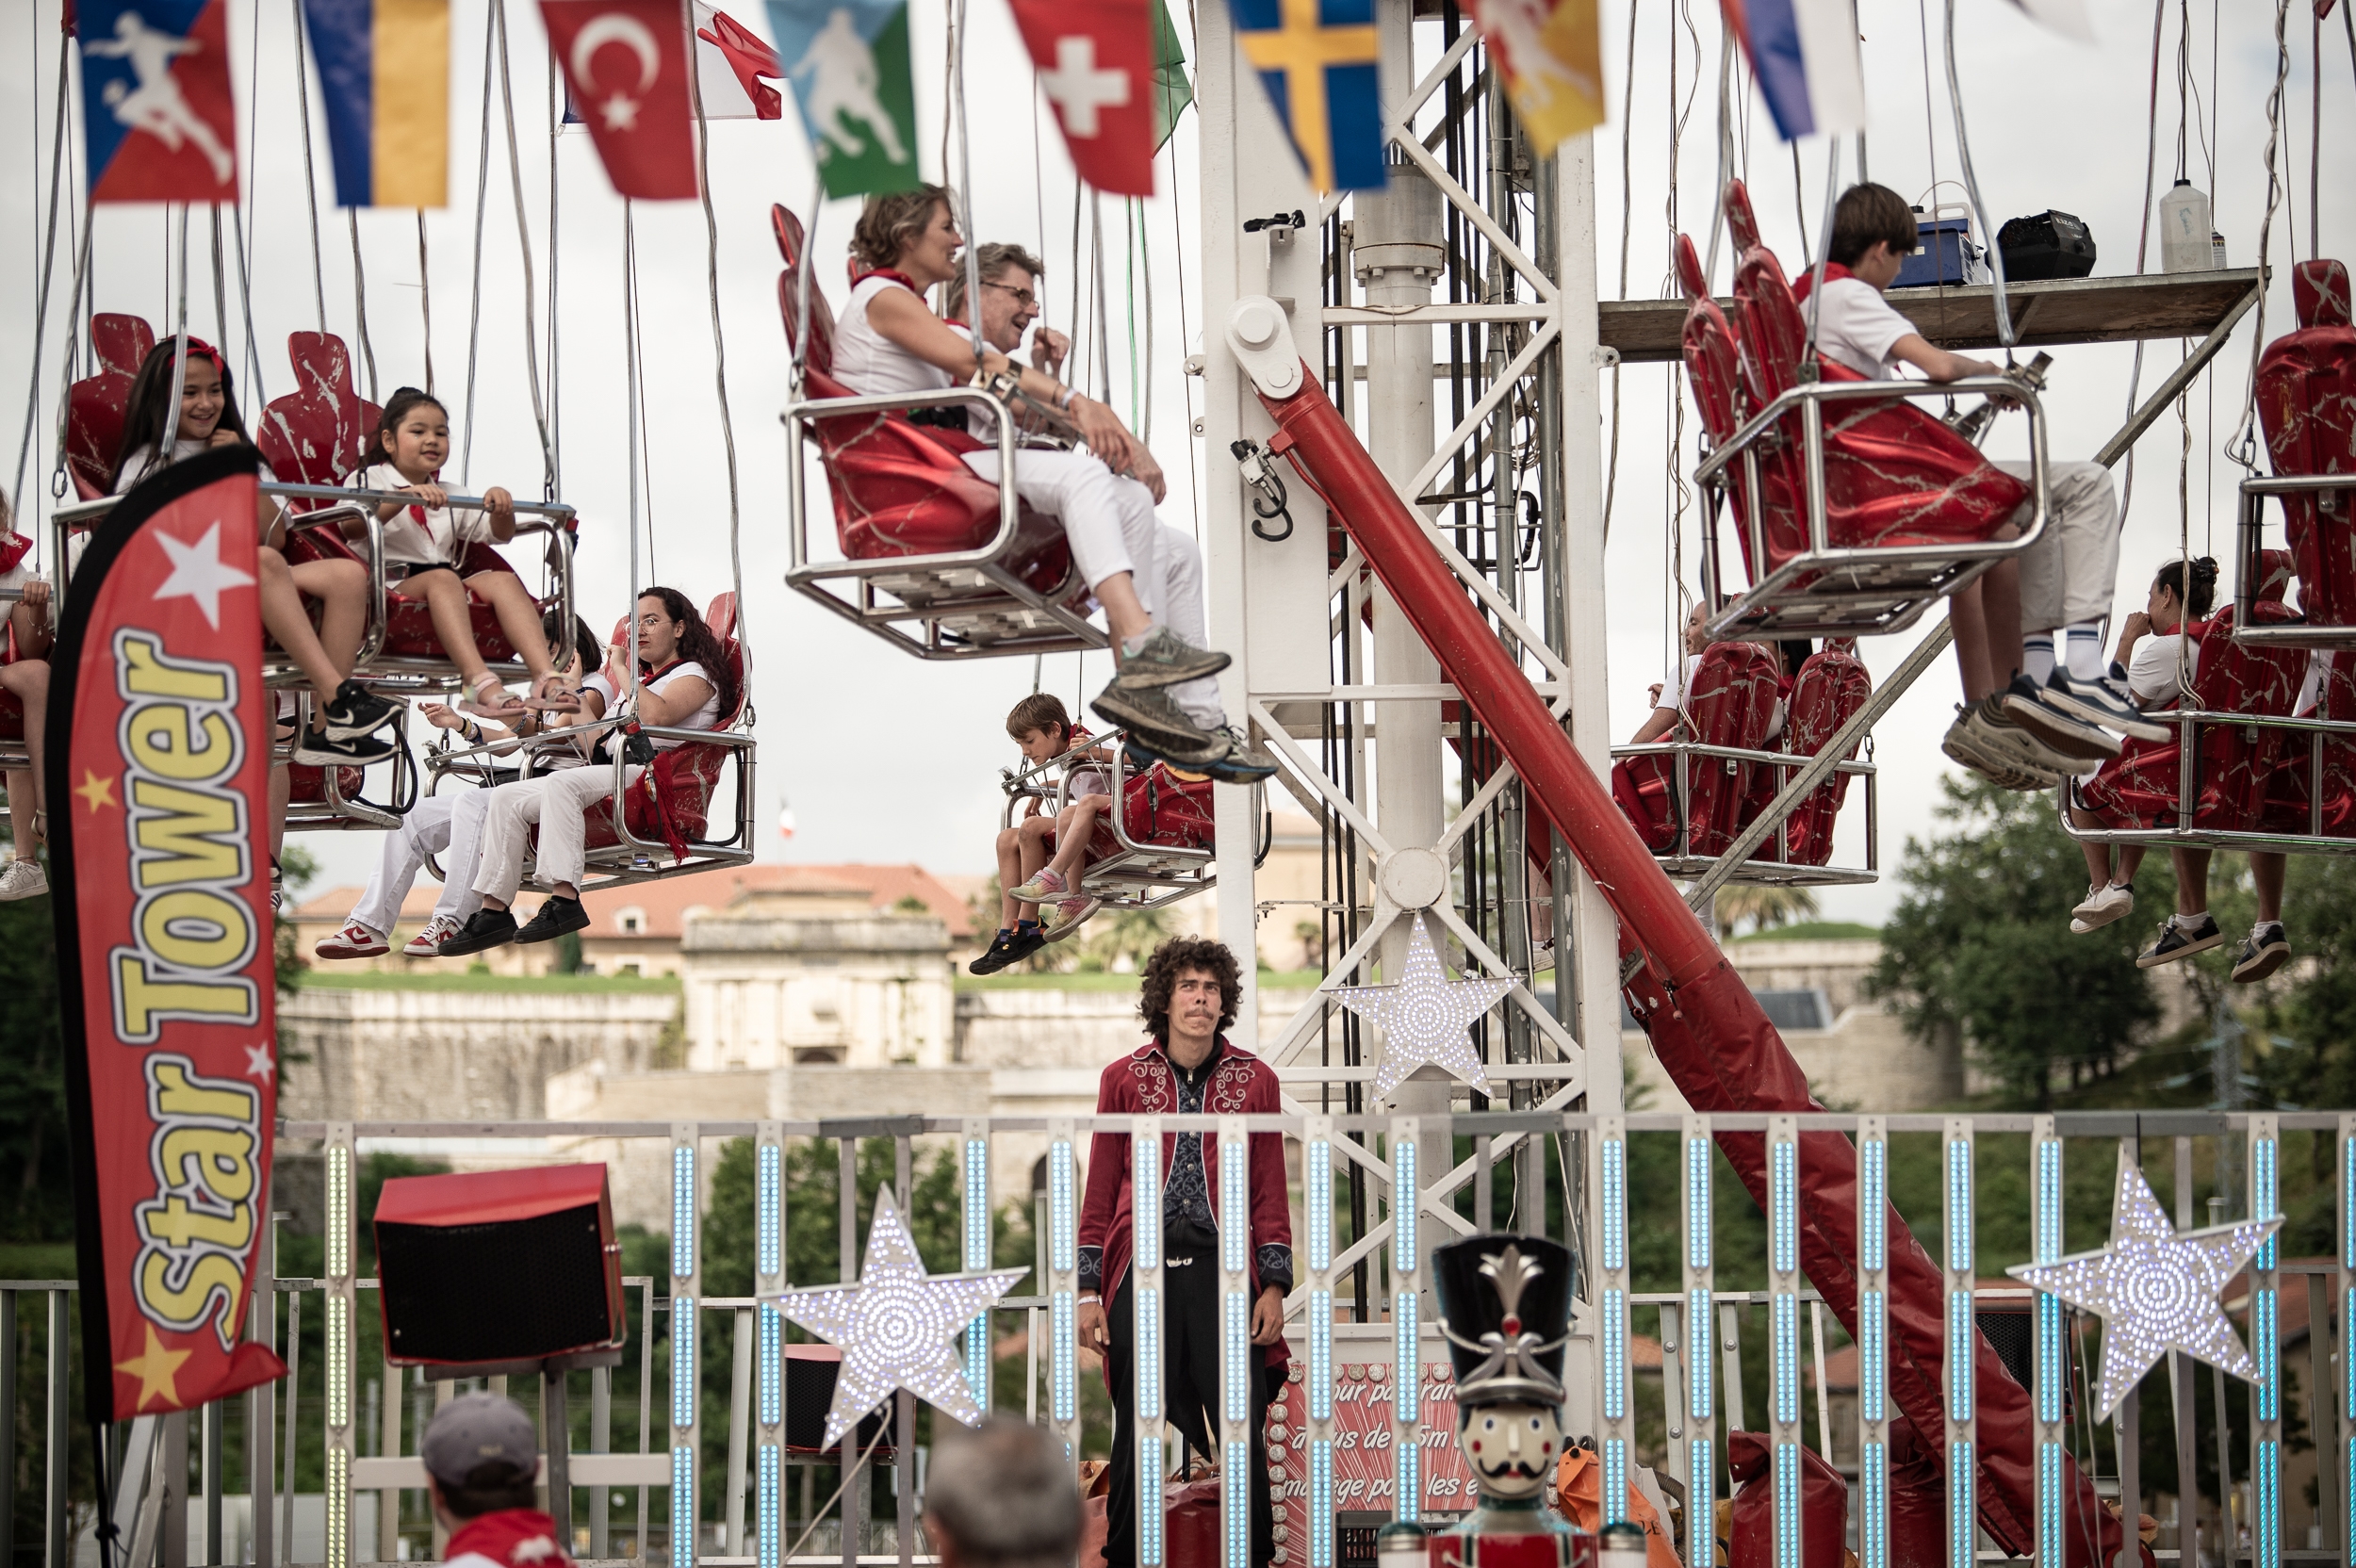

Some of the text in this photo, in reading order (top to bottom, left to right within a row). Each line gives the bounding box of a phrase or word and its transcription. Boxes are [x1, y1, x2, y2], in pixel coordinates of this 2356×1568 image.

[109, 626, 261, 1351] Star Tower
[1364, 1421, 1391, 1449] de
[1426, 1472, 1461, 1496] les
